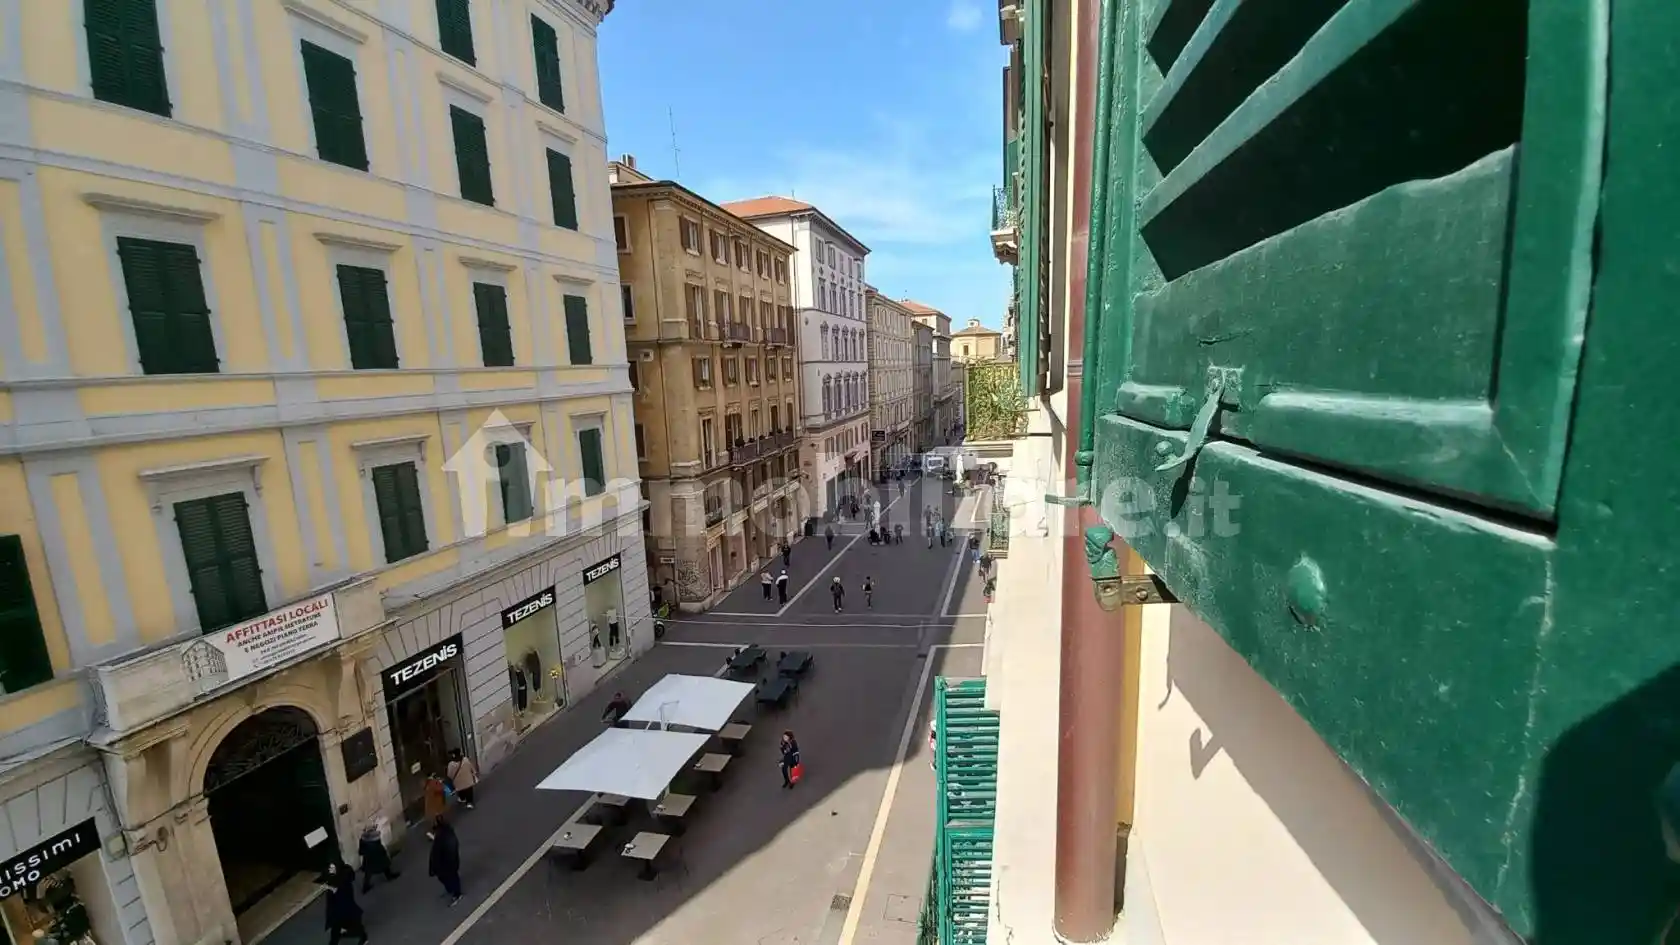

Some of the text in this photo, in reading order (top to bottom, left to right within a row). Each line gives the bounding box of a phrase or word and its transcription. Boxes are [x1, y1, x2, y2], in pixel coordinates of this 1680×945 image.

[585, 558, 619, 582] TEZENIS
[226, 614, 287, 644] AFFITTASI
[290, 599, 328, 619] LOCALI
[507, 593, 553, 625] TEZENIS
[238, 634, 261, 647] ANCHE
[250, 637, 276, 651] NEGOZI
[277, 629, 298, 640] PIANO
[299, 621, 319, 632] TERRA
[390, 643, 458, 686] TEZENIS
